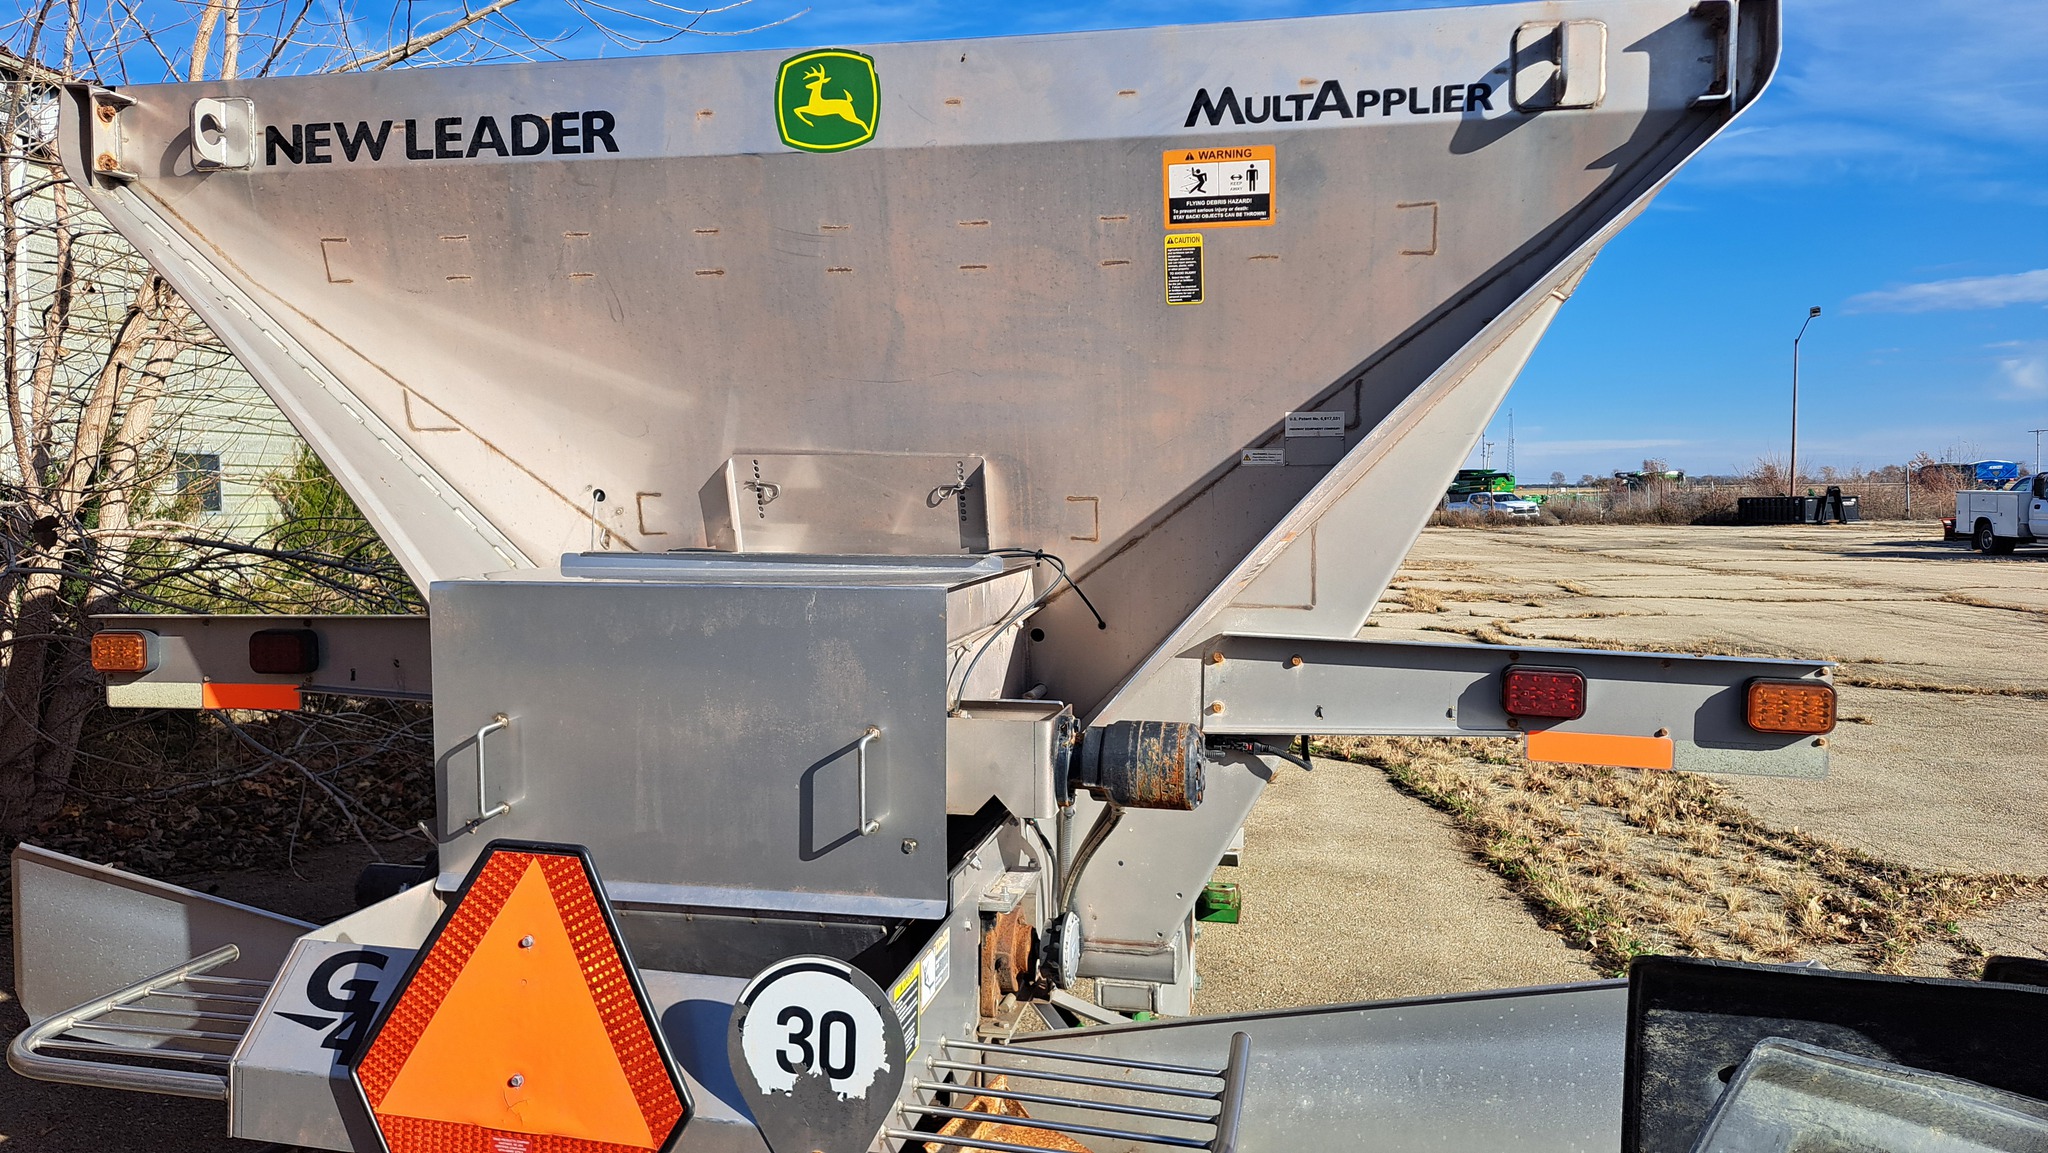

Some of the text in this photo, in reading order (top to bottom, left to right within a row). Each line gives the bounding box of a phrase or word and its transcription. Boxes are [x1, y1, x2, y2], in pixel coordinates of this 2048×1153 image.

[264, 110, 620, 166] NEW LEADER
[1198, 148, 1252, 160] WARNING
[1174, 236, 1200, 244] CAUTION
[775, 1004, 857, 1080] 30
